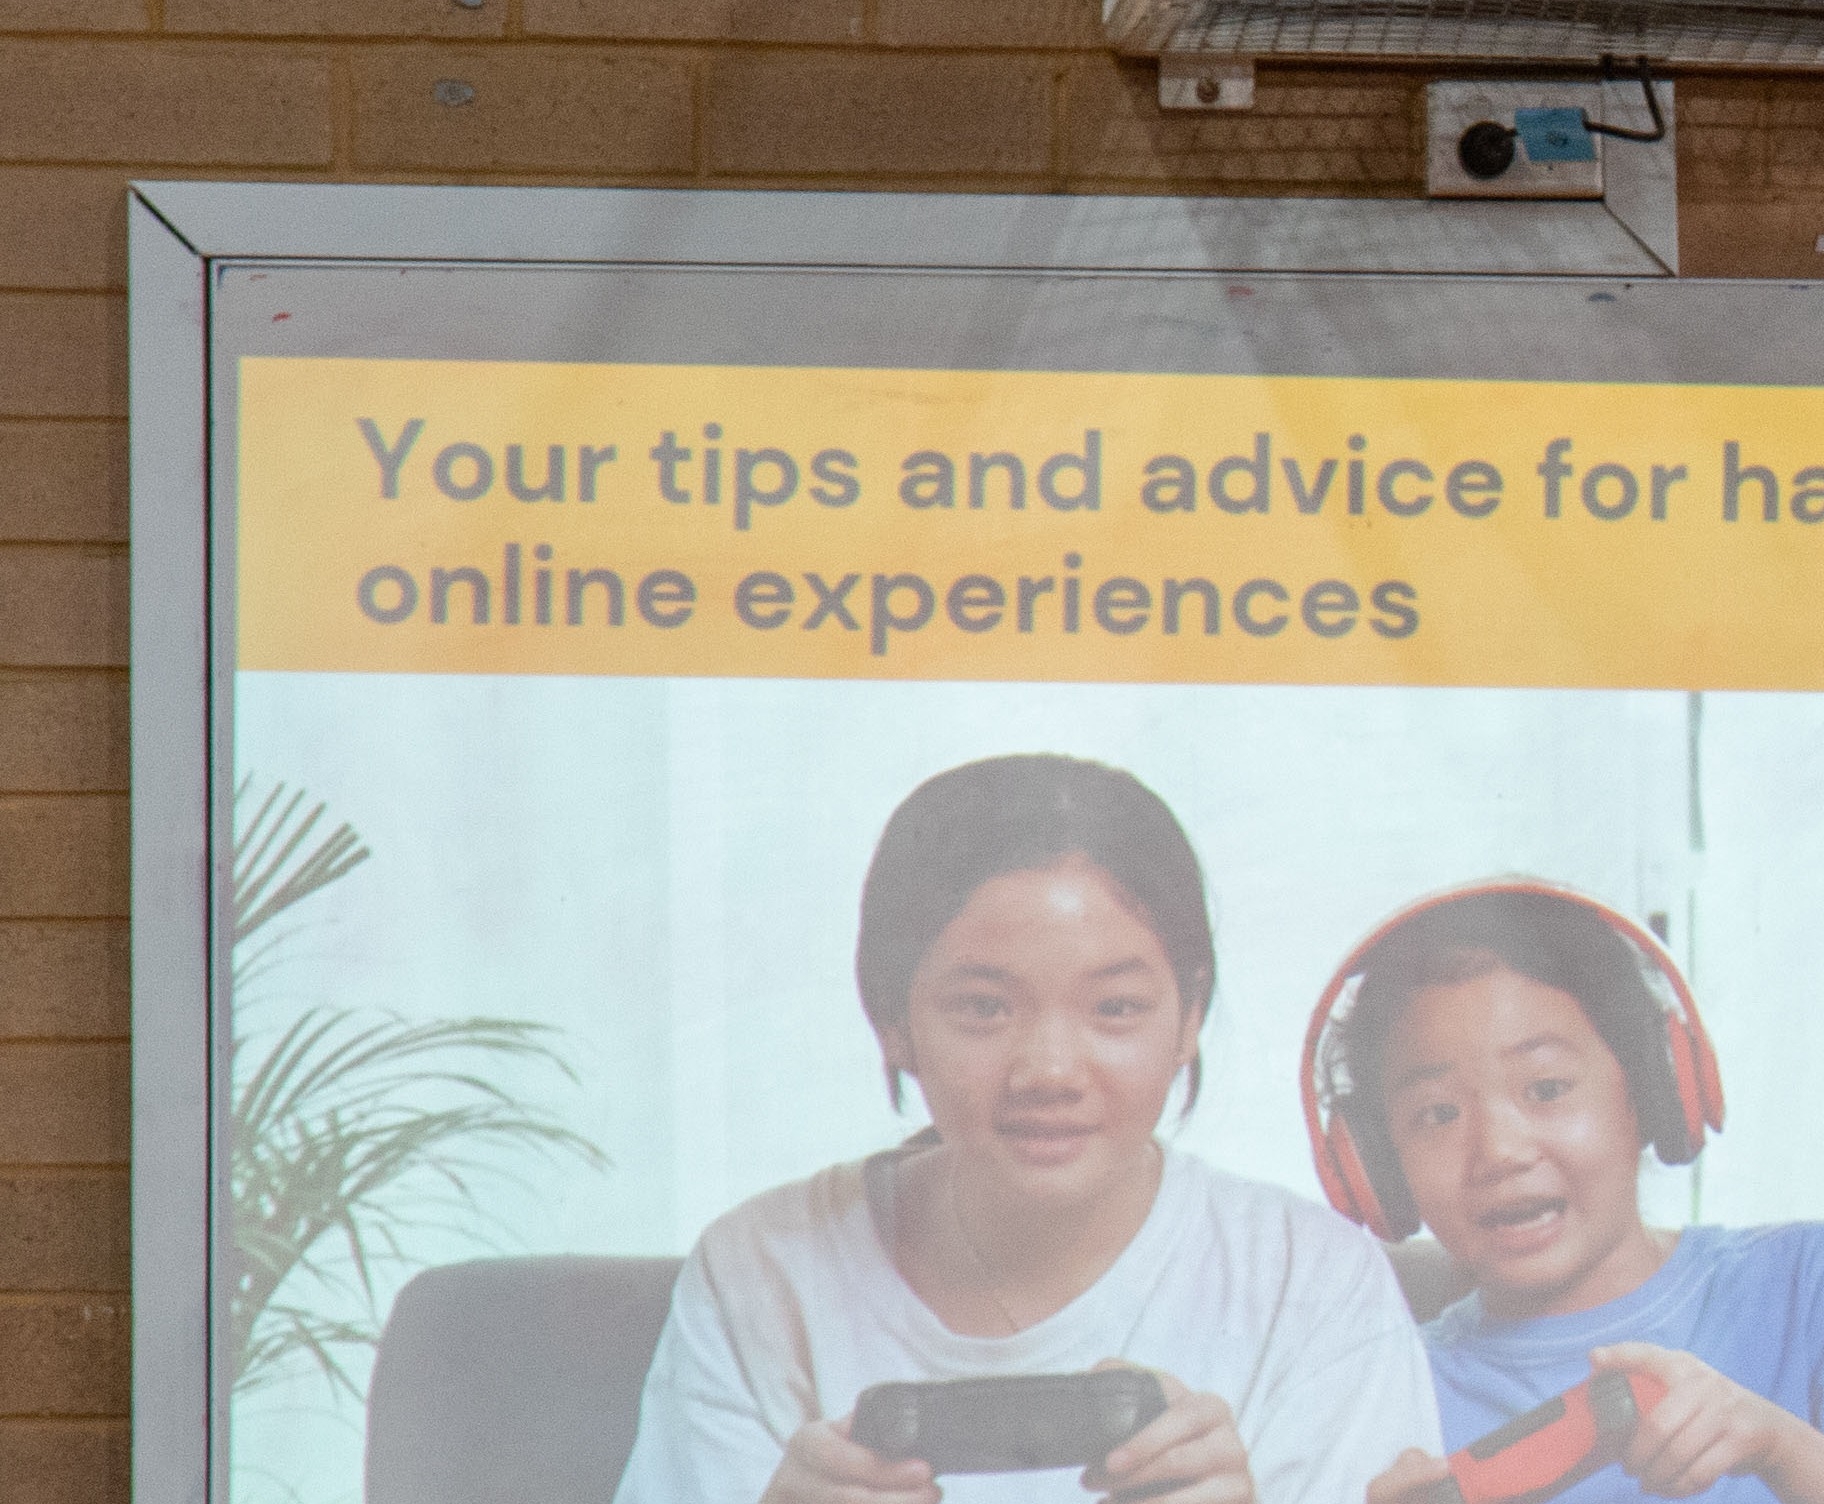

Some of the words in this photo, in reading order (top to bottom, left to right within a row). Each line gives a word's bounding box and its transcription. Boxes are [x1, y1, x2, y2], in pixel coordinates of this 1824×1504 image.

[357, 417, 618, 504] Your
[649, 421, 861, 532] tips
[897, 428, 1102, 513] and
[1139, 431, 1505, 520] advice
[1535, 436, 1689, 523] for
[356, 541, 698, 630] online
[732, 551, 1421, 659] experiences
